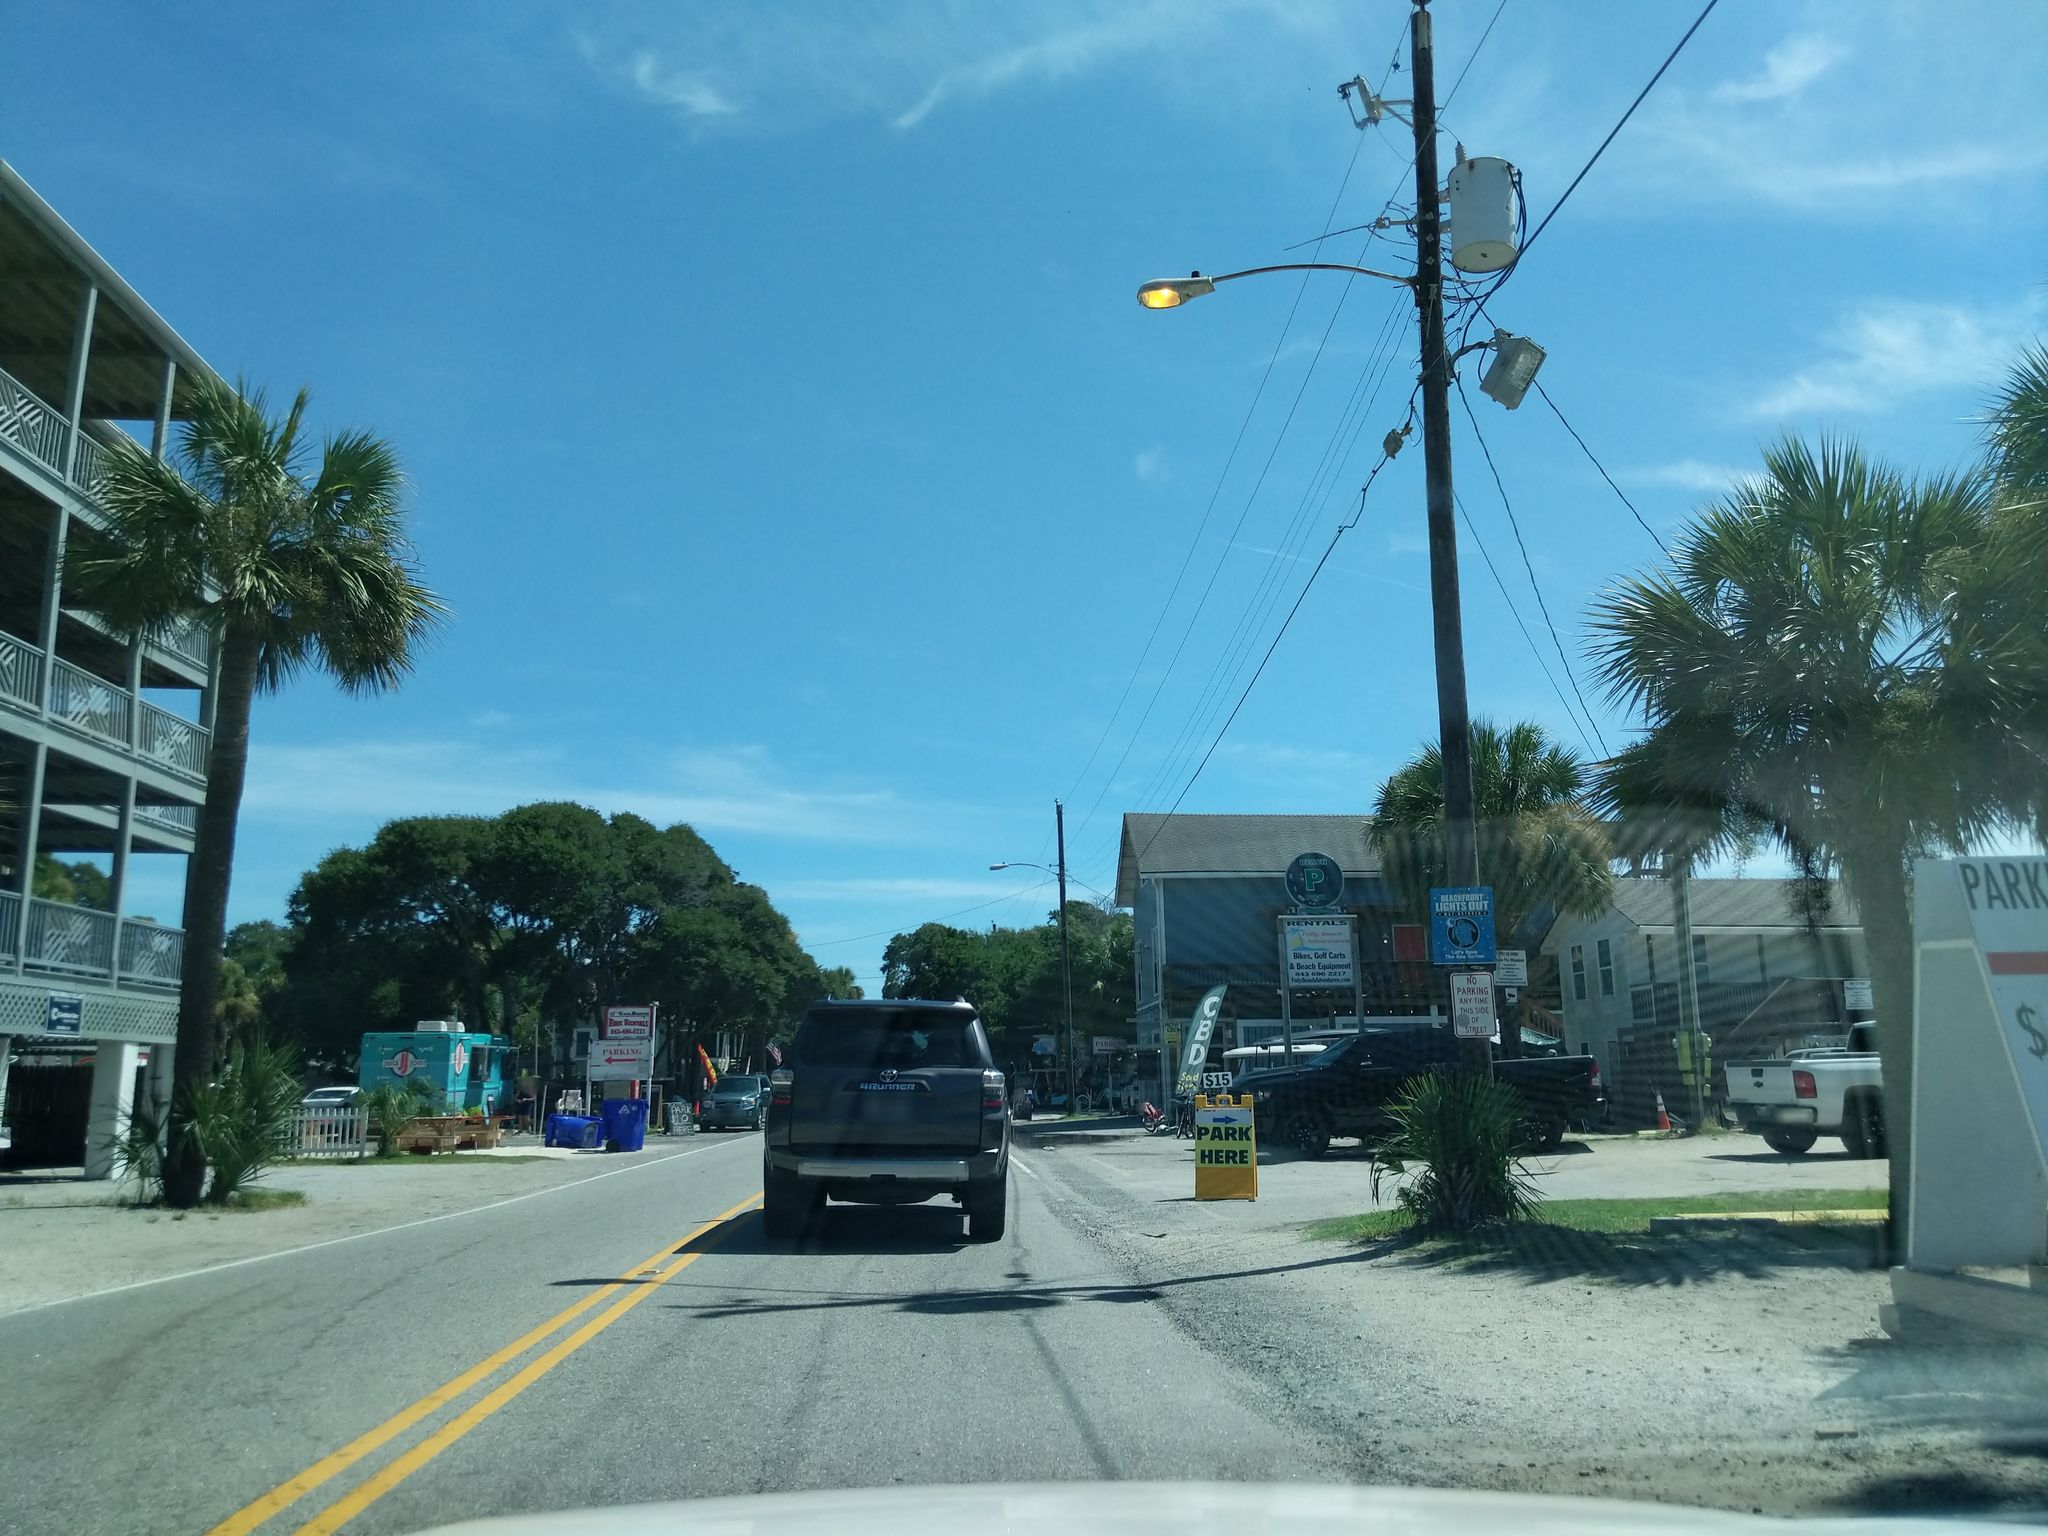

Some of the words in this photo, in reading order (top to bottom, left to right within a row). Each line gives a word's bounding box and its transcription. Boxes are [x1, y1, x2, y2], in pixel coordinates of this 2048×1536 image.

[1304, 868, 1325, 892] P
[1959, 862, 2048, 910] PARK
[1435, 901, 1467, 912] LIGHTS
[1468, 900, 1489, 911] OUT
[1293, 952, 1313, 961] Bikes,
[1296, 962, 1317, 970] Beach
[1318, 962, 1352, 971] Equipment
[1466, 976, 1478, 985] NO
[1456, 986, 1489, 996] PARKING
[1459, 997, 1473, 1005] ANY
[1474, 997, 1489, 1005] TIME
[1460, 1007, 1474, 1015] THIS
[1474, 1006, 1489, 1014] SIDE
[1188, 996, 1221, 1066] CBD
[1465, 1026, 1488, 1034] STREET
[602, 1047, 642, 1056] PARKING
[1204, 1073, 1230, 1088] $15
[859, 1082, 916, 1090] 4RUNNER
[1196, 1126, 1252, 1141] PARK
[1200, 1149, 1249, 1165] HERE
